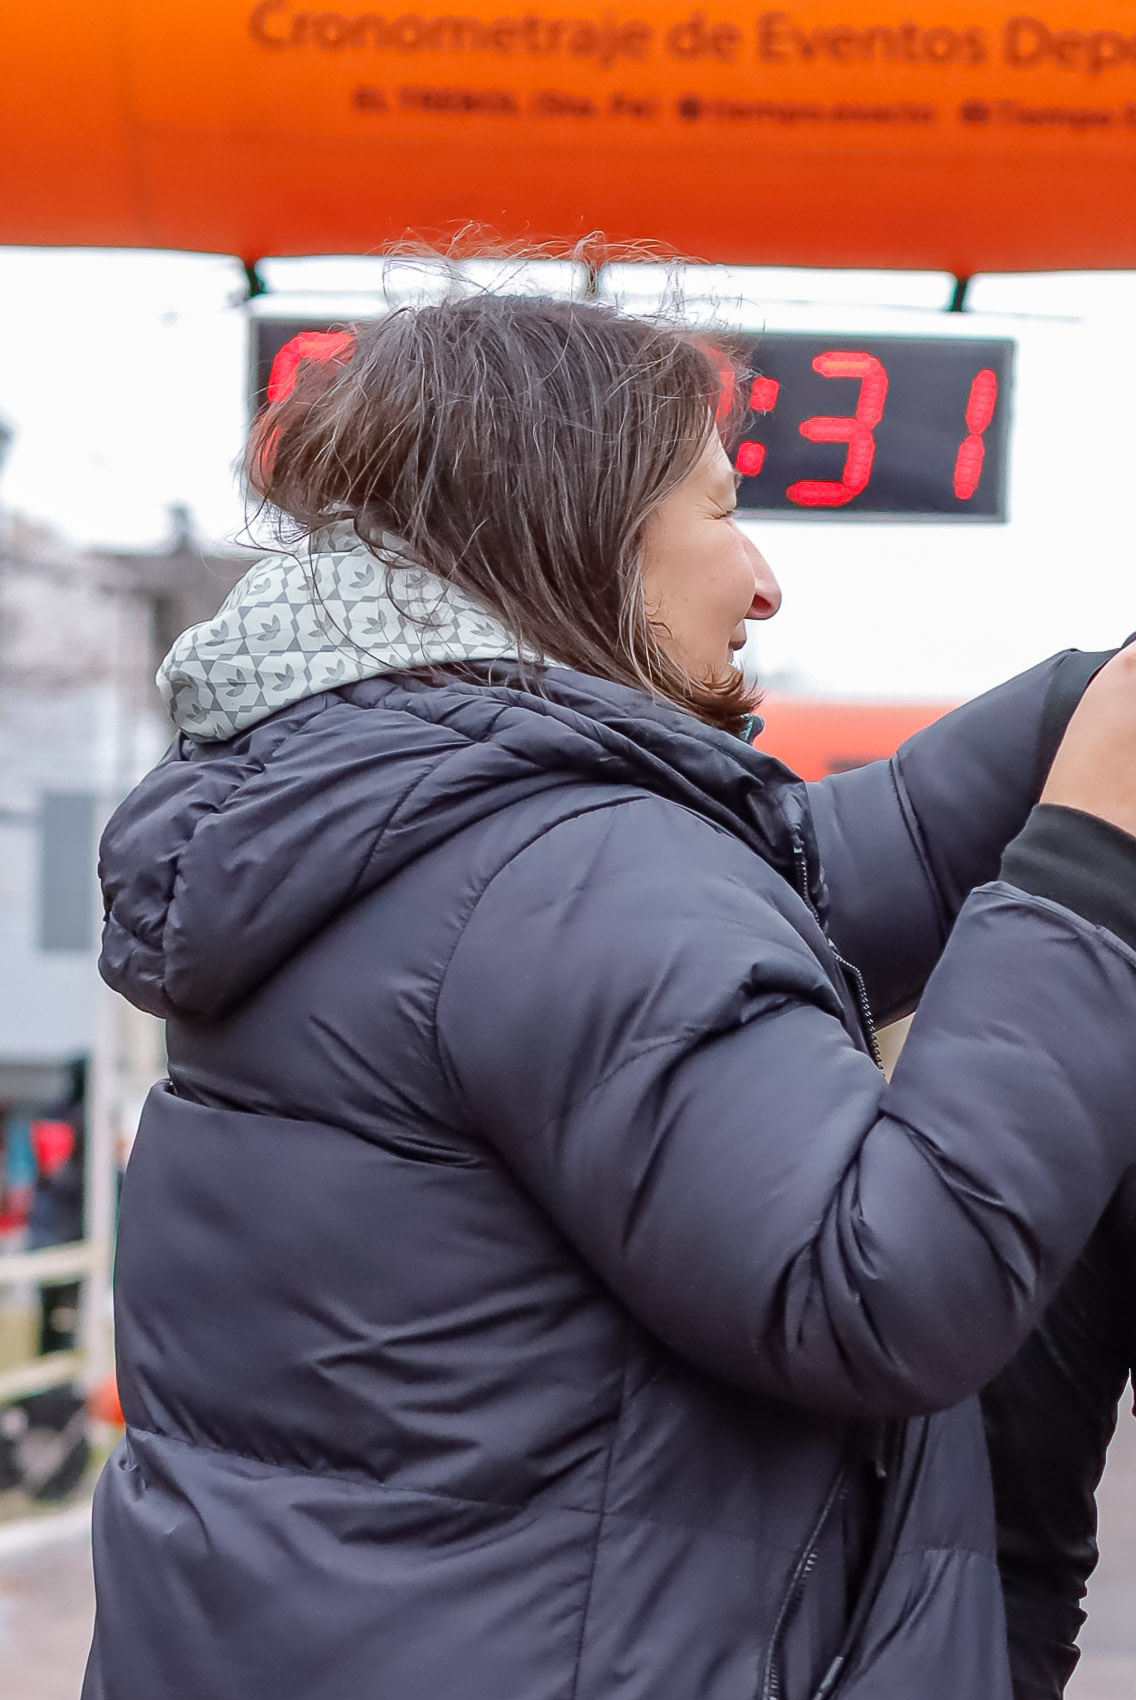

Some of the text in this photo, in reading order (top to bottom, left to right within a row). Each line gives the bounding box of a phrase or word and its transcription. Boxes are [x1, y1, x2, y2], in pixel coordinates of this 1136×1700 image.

[248, 1, 652, 69] Cronometraje
[665, 5, 741, 62] de
[756, 10, 989, 67] Eventos
